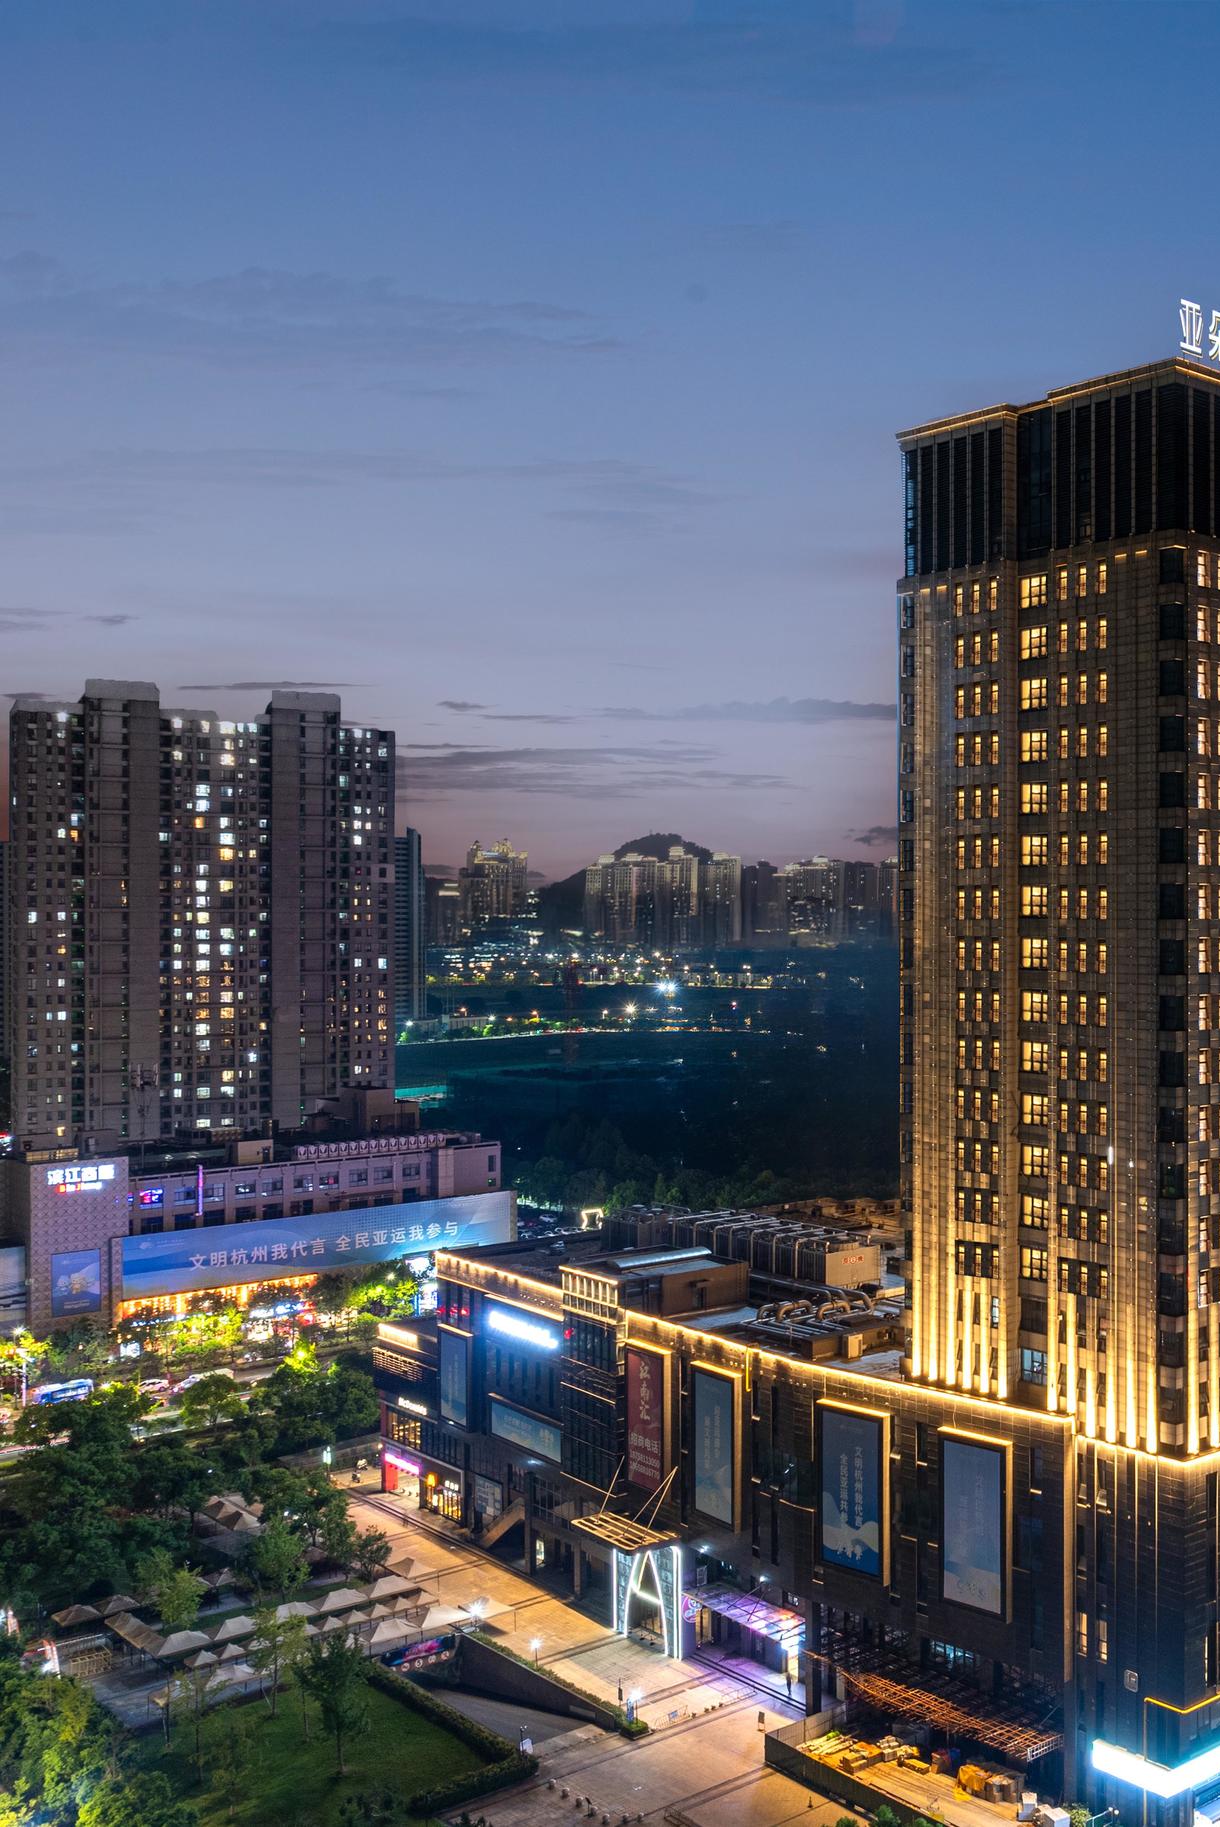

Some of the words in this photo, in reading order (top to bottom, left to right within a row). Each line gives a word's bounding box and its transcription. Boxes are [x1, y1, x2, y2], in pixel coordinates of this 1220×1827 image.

[189, 1238, 326, 1271] 文明杭州我代言
[335, 1221, 459, 1252] 全民亚运我参与
